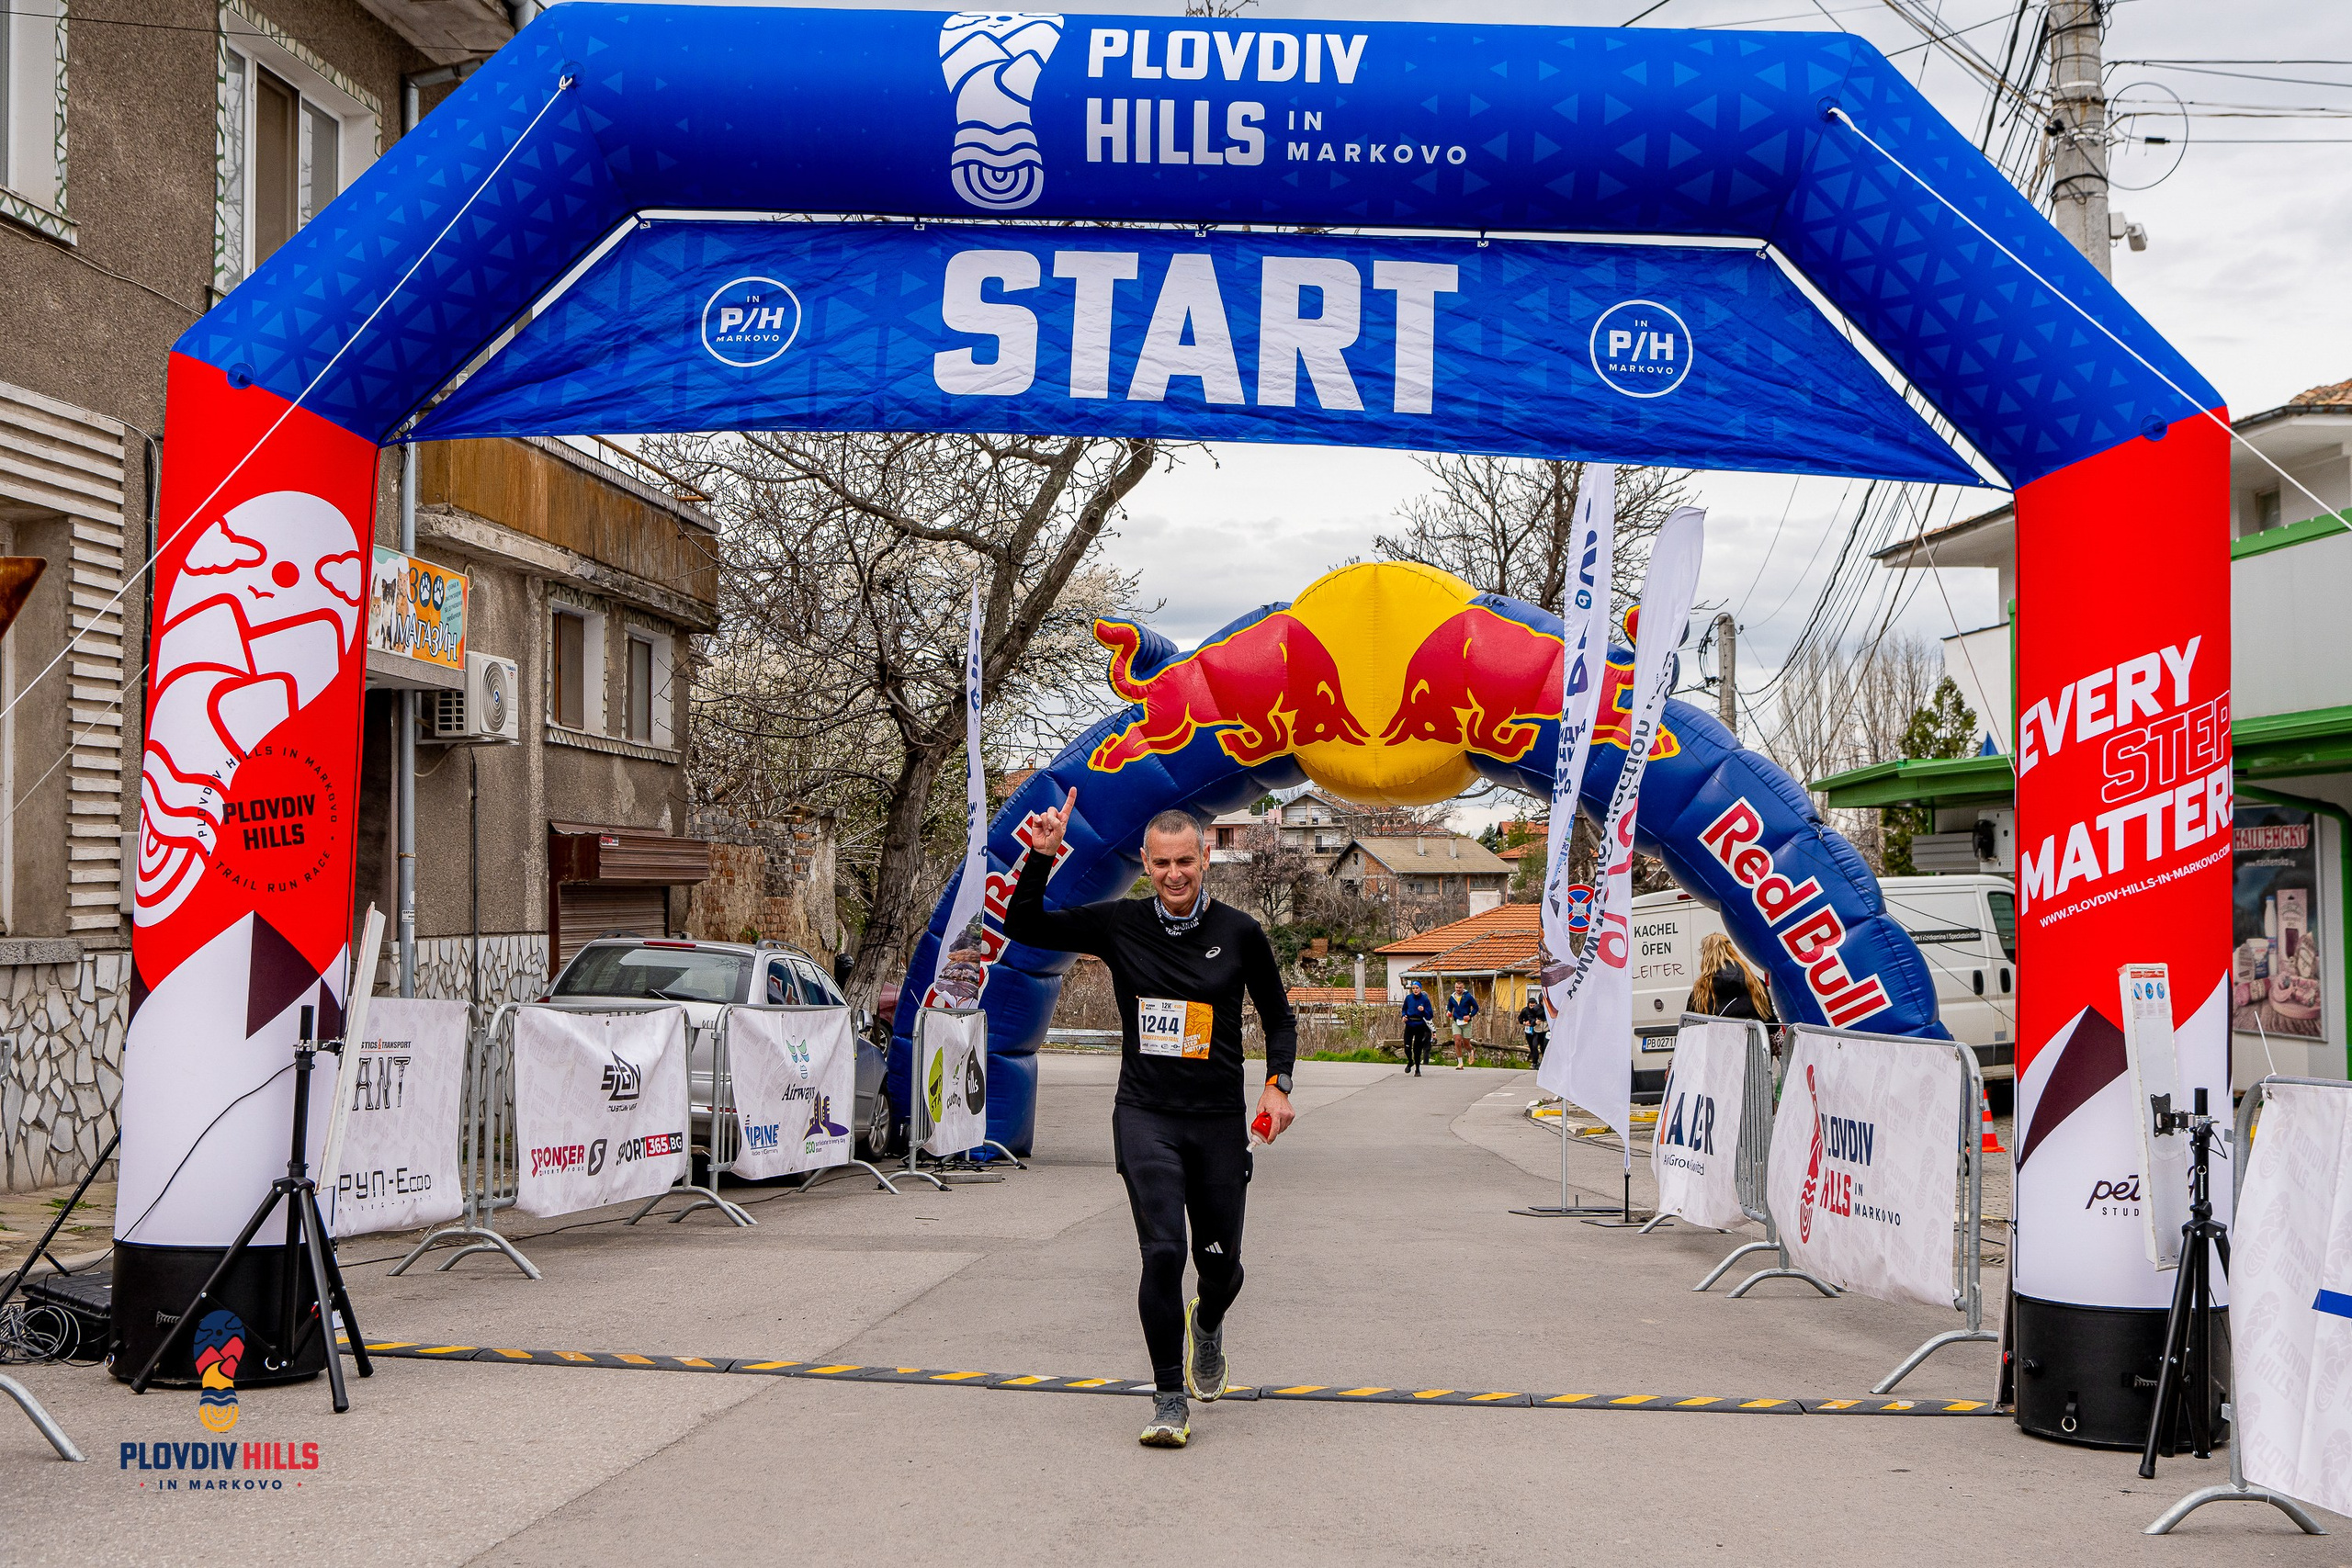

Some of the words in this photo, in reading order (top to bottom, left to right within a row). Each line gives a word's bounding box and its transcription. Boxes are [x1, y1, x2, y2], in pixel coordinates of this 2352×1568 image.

[1087, 28, 1369, 84] PLOVDIV
[1086, 98, 1265, 166] HILLS
[1287, 111, 1322, 130] IN
[1287, 141, 1467, 164] MARKOVO
[746, 295, 760, 303] IN
[719, 307, 785, 333] P/H
[933, 249, 1459, 414] START
[716, 334, 779, 343] MARKOVO
[1609, 330, 1674, 362] P/H
[1609, 364, 1674, 375] MARKOVO
[396, 613, 458, 661] МАГАЗИН
[2019, 635, 2201, 778] EVERY
[2101, 690, 2231, 804] STEP
[198, 770, 221, 838] PLOVDIV
[226, 746, 273, 769] HILLS
[283, 747, 298, 759] IN
[305, 757, 337, 822] MARKOVO
[222, 795, 315, 825] PLOVDIV
[243, 823, 305, 851] HILLS
[216, 861, 257, 890] TRAIL
[267, 879, 298, 893] RUN
[304, 851, 330, 882] RACE
[1700, 798, 1822, 925] Red
[2040, 842, 2231, 928] WWW.PLOVDIV-HILLS-IN-MARKOVO.COM
[1634, 922, 1679, 938] KACHEL
[1641, 942, 1671, 956] ÖFEN
[1779, 905, 1892, 1029] Bull
[1141, 1015, 1180, 1034] 1244
[1646, 1038, 1657, 1048] PB
[1657, 1037, 1673, 1048] 0271
[781, 1083, 816, 1104] Airways
[531, 1145, 585, 1178] SPONSER
[1855, 1182, 1863, 1196] IN
[1854, 1202, 1901, 1226] MARKOVO
[2102, 1206, 2140, 1216] STUD
[2268, 1328, 2311, 1387] PLOVDI
